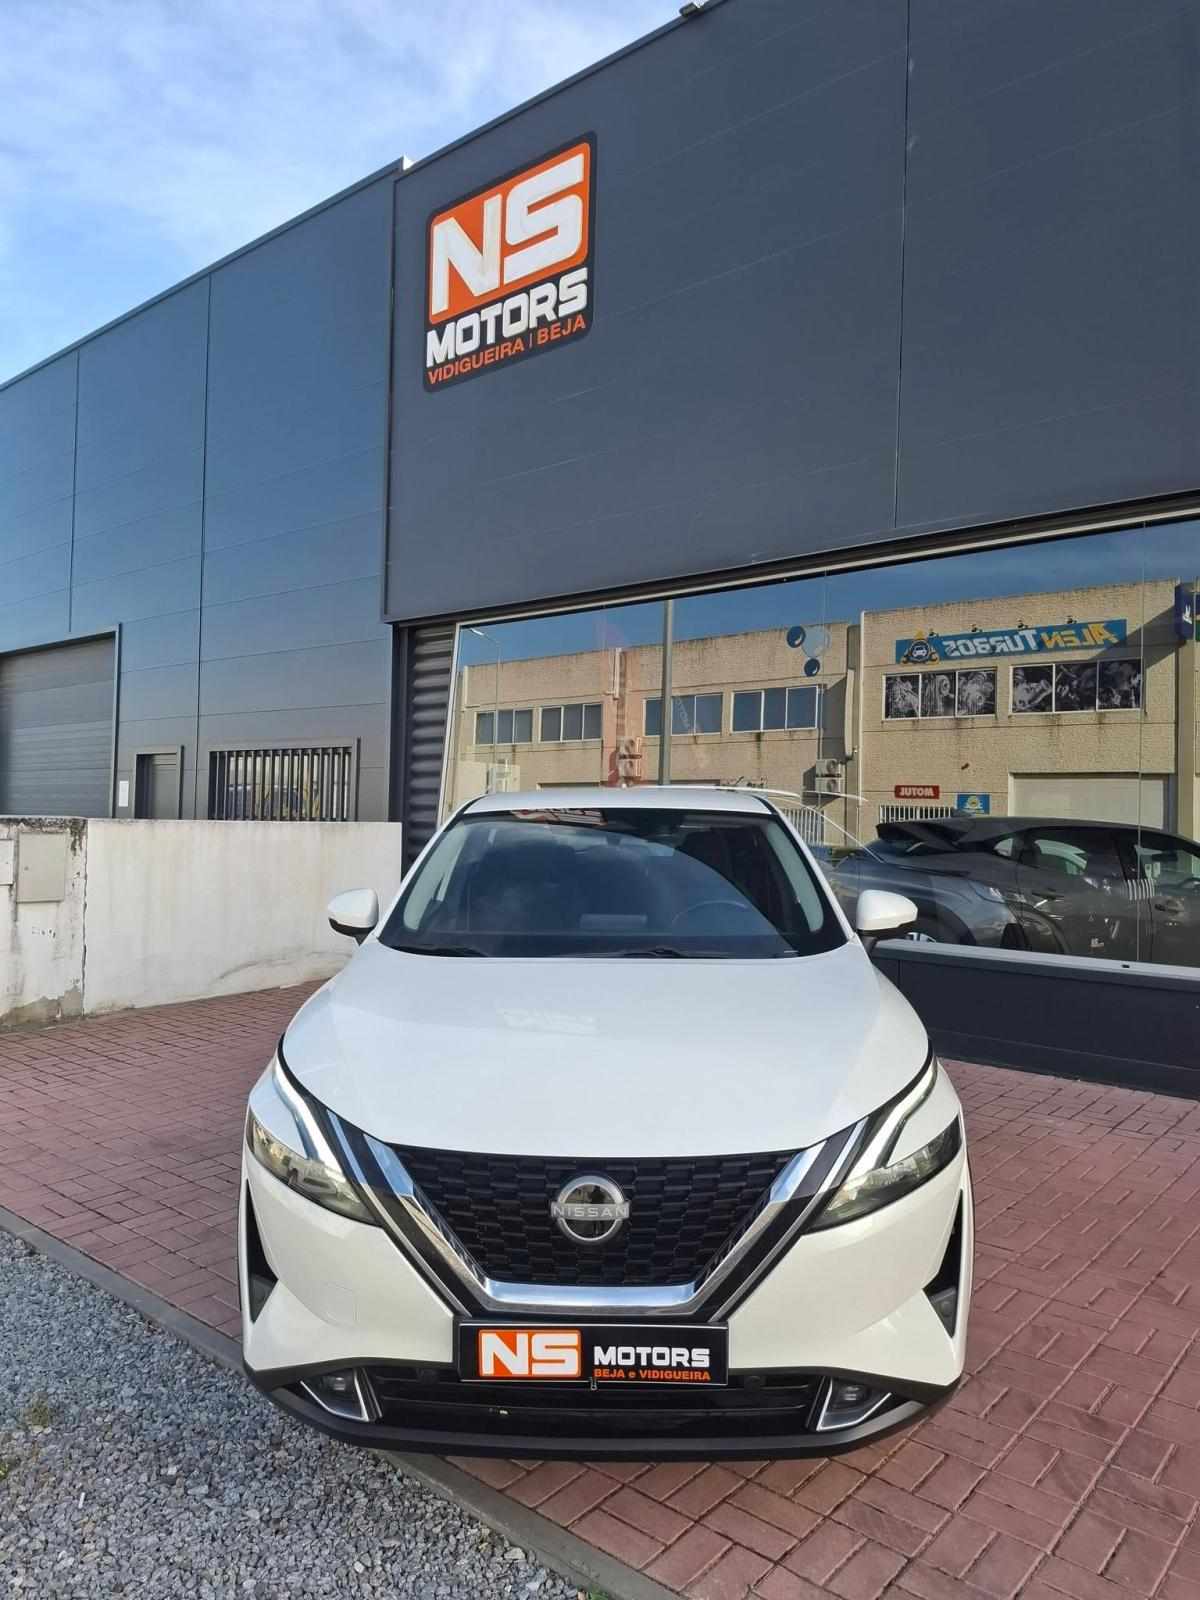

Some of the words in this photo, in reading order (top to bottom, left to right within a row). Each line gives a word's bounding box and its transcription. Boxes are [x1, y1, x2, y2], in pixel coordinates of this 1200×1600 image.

[432, 153, 584, 315] NS
[426, 267, 588, 368] MOTORS
[427, 337, 524, 384] VIDIGUEIRA
[537, 313, 586, 345] BEJA
[553, 1206, 627, 1217] NISSAN
[481, 1332, 578, 1375] NS
[594, 1346, 710, 1368] MOTORS
[594, 1368, 625, 1378] BEJA
[639, 1370, 711, 1380] VIDIGUEIRA
